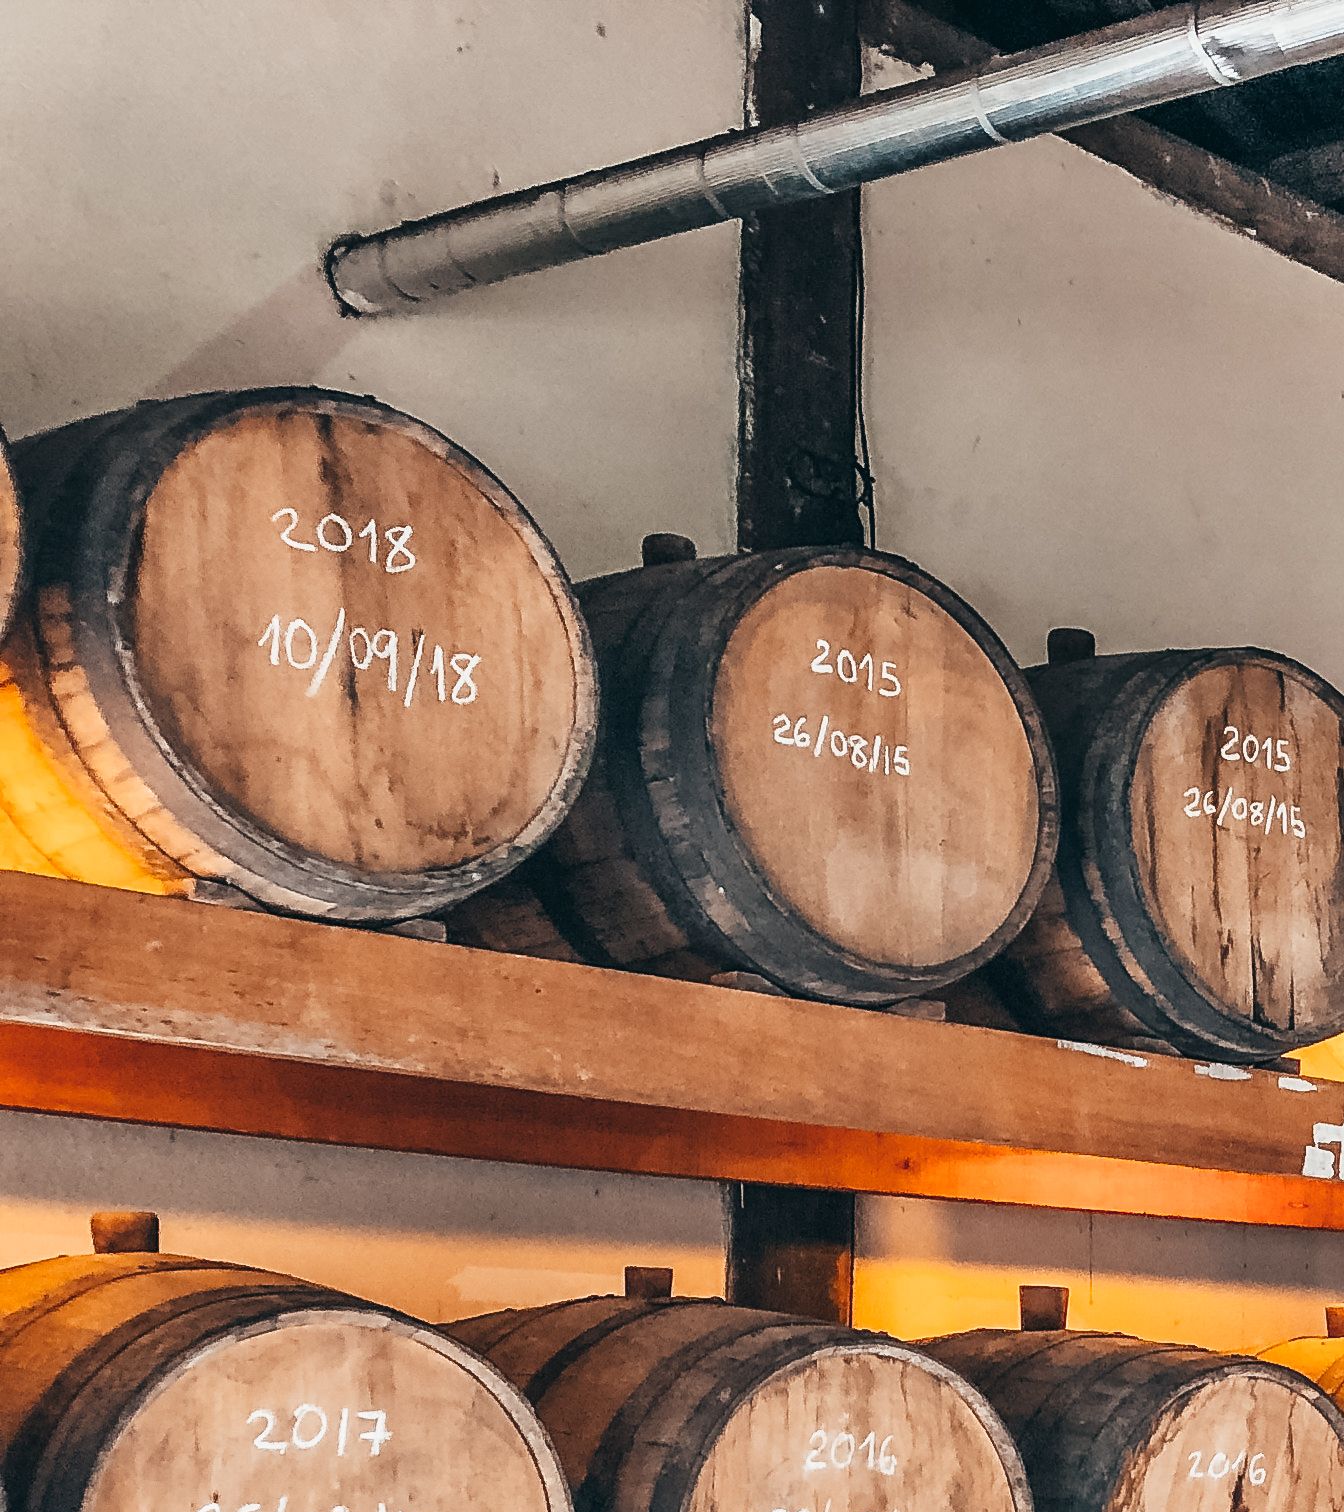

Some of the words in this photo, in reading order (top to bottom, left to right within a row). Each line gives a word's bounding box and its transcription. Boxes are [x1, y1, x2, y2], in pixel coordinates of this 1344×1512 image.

[271, 507, 416, 573] 2018
[257, 607, 482, 708] 10/09/18
[811, 639, 902, 698] 2015
[772, 713, 911, 776] 26/08/15
[1220, 726, 1291, 772] 2015
[1183, 787, 1306, 839] 26/08/15
[247, 1403, 393, 1457] 2017
[803, 1429, 897, 1476] 2016
[1188, 1450, 1267, 1486] 2016
